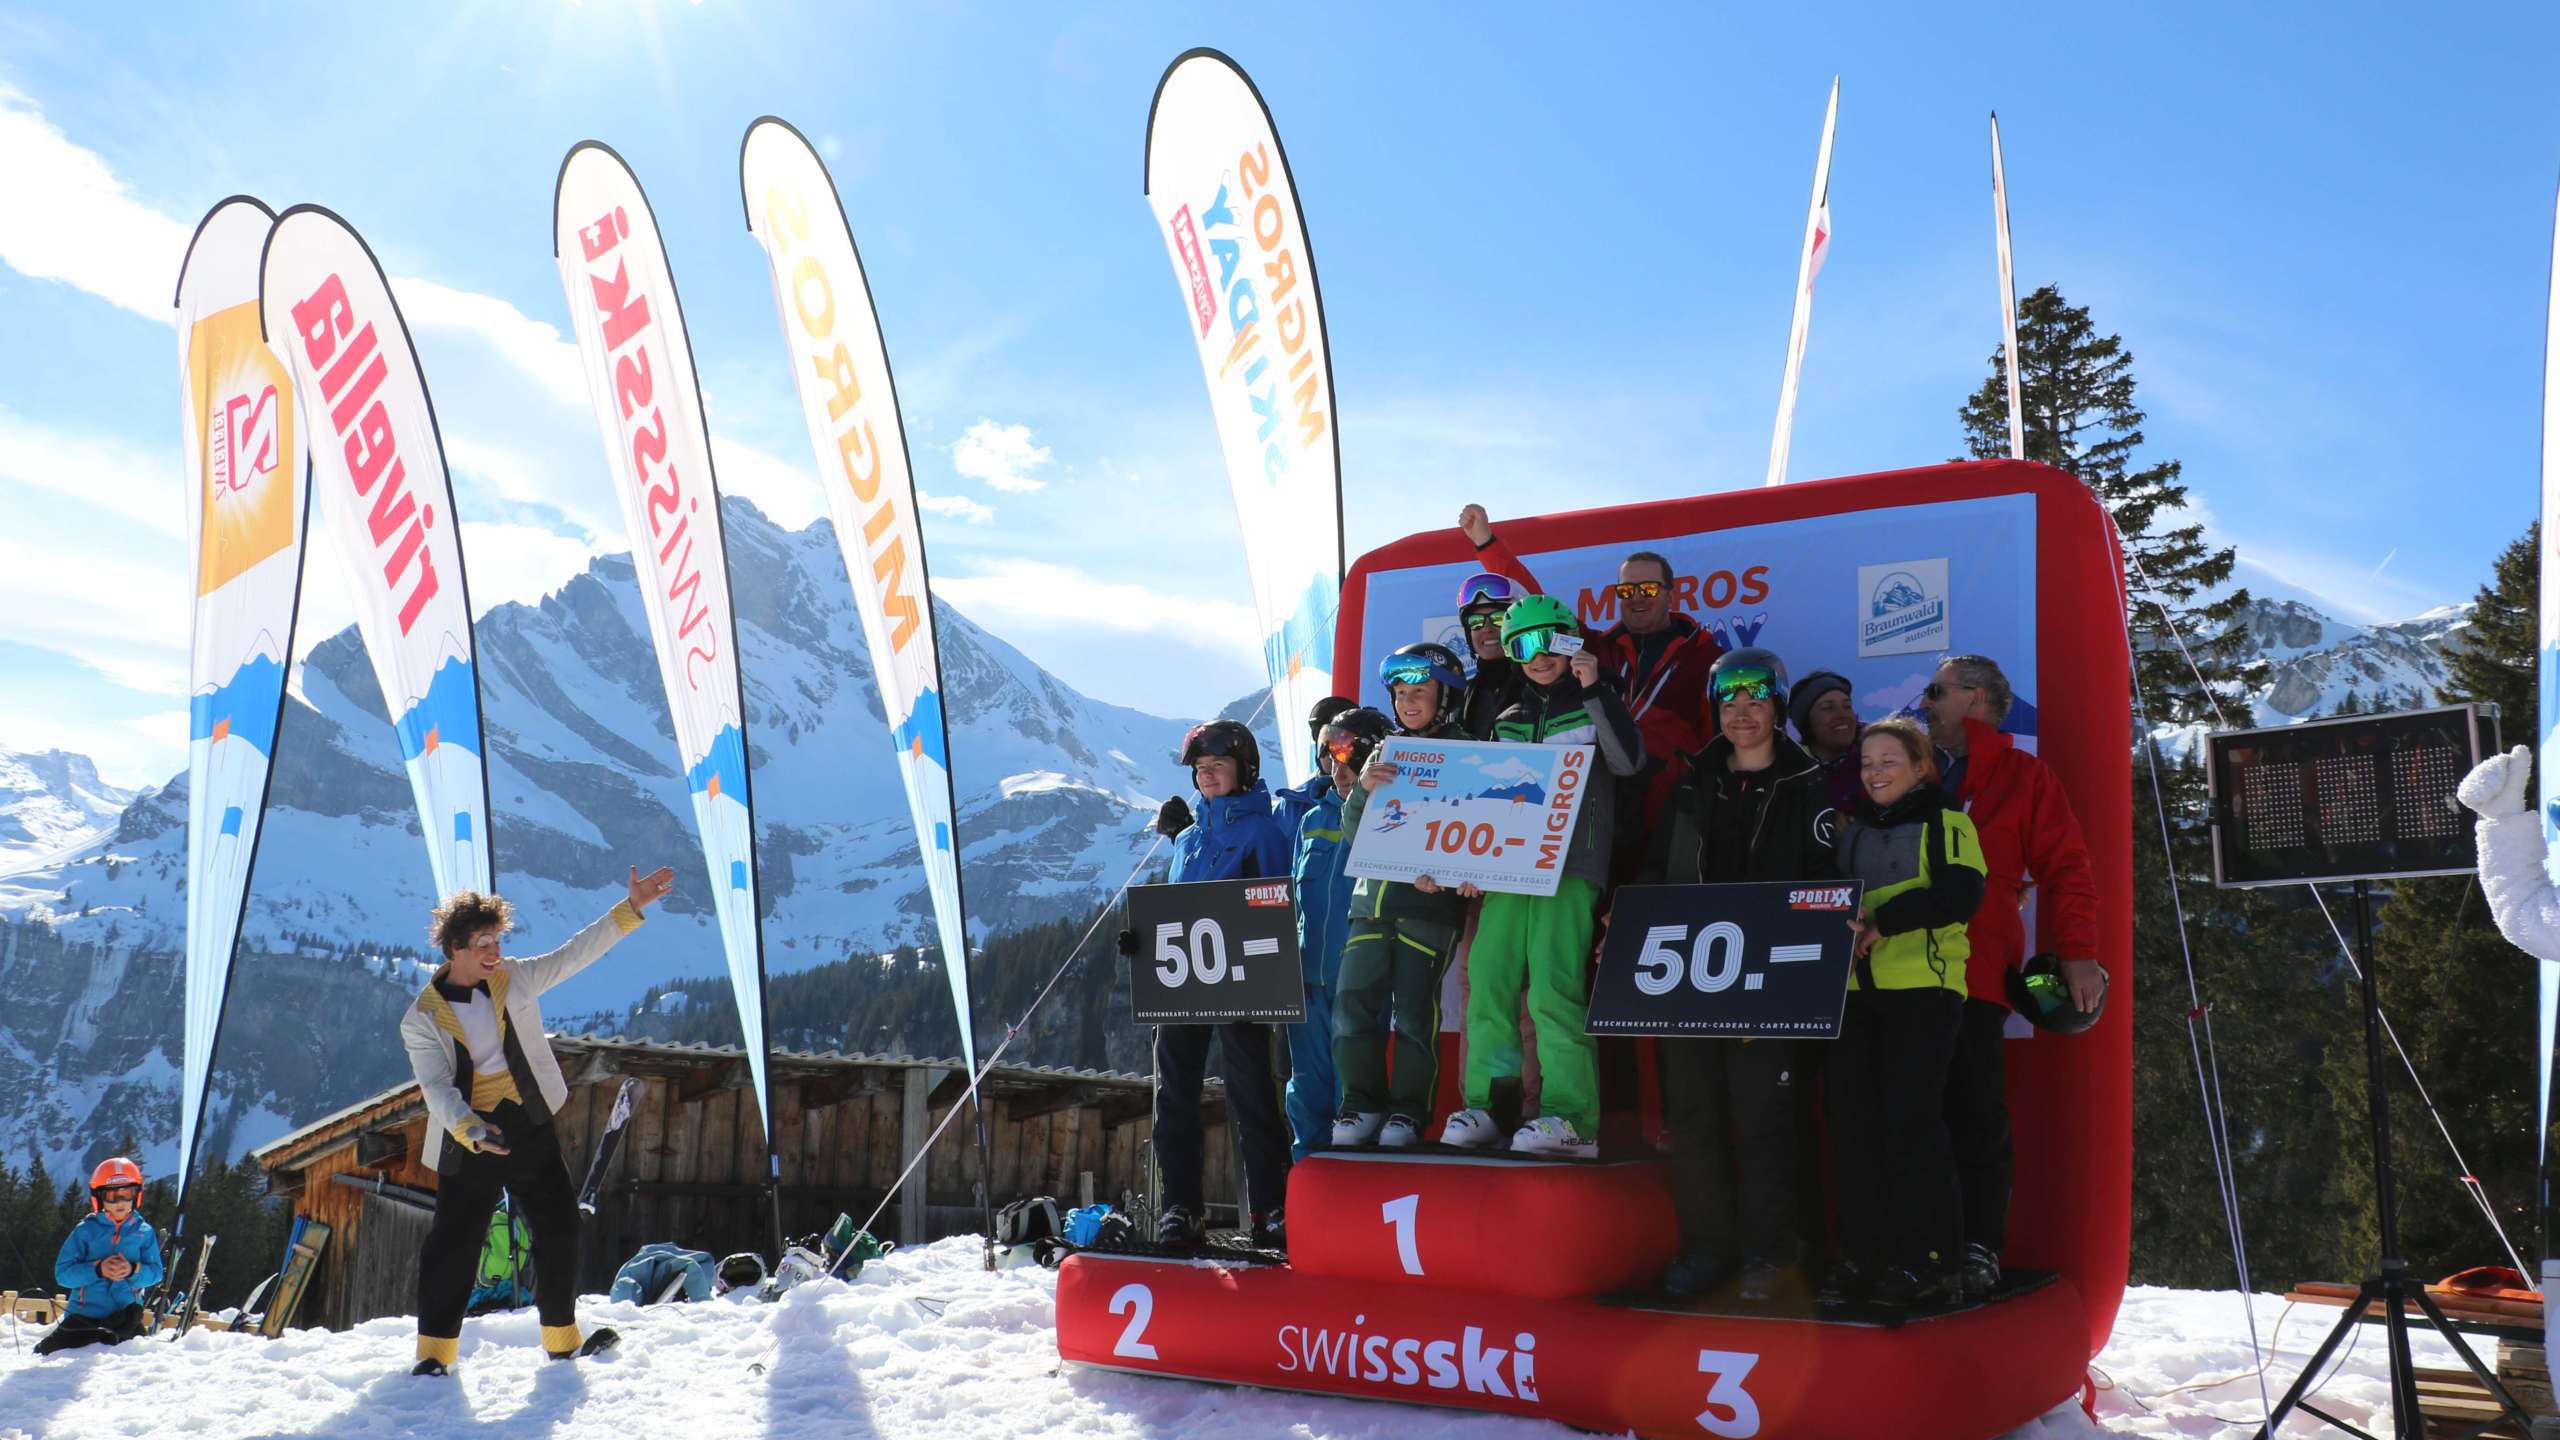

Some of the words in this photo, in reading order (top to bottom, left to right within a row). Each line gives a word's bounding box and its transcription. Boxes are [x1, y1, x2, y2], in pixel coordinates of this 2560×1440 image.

[1577, 565, 1770, 622] MROS
[1864, 600, 1937, 637] Braunwald
[1904, 622, 1944, 643] autofrei
[1393, 750, 1446, 764] MIGROS
[1414, 766, 1440, 778] DAY
[1535, 750, 1585, 870] MIGROS
[1244, 883, 1290, 904] SPORTXX
[1788, 887, 1854, 908] SPORTXX
[1759, 1022, 1791, 1030] CARTA
[1793, 1022, 1832, 1030] REGALO
[1381, 1195, 1426, 1276] 1
[1108, 1284, 1159, 1361] 2
[1276, 1314, 1540, 1402] swissski
[1695, 1350, 1761, 1438] 3
